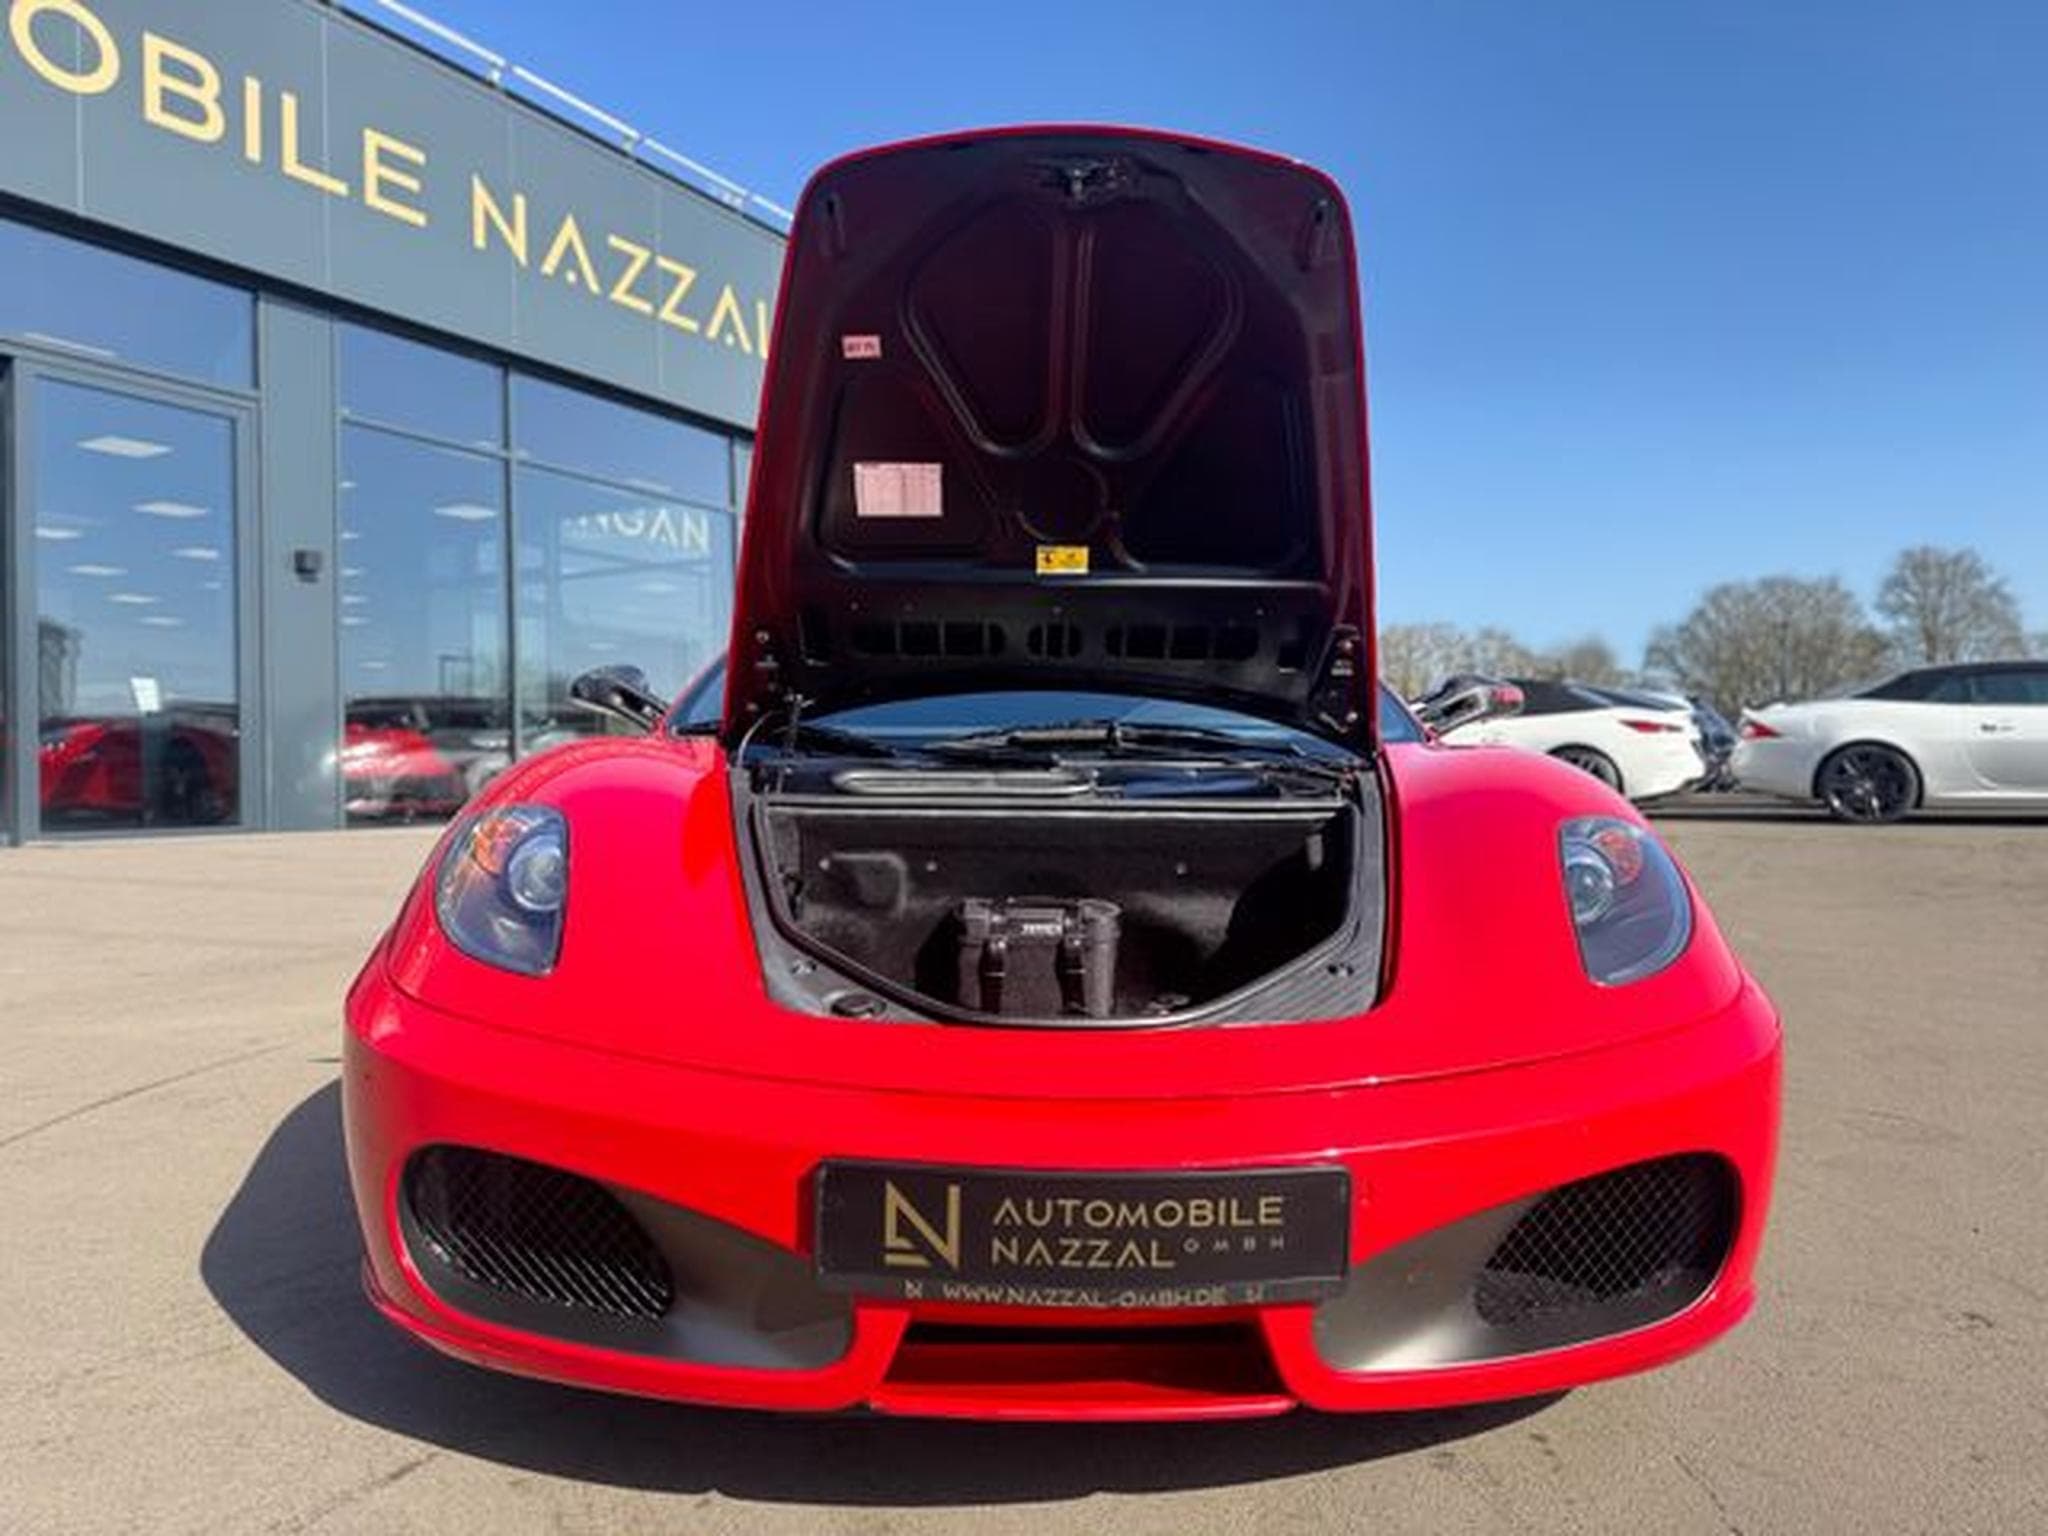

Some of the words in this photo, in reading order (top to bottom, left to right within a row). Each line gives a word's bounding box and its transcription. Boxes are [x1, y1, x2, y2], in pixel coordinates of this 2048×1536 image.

[9, 0, 428, 228] OBILE
[991, 1197, 1285, 1228] AUTOMOBILE
[990, 1237, 1176, 1269] NAZZAL
